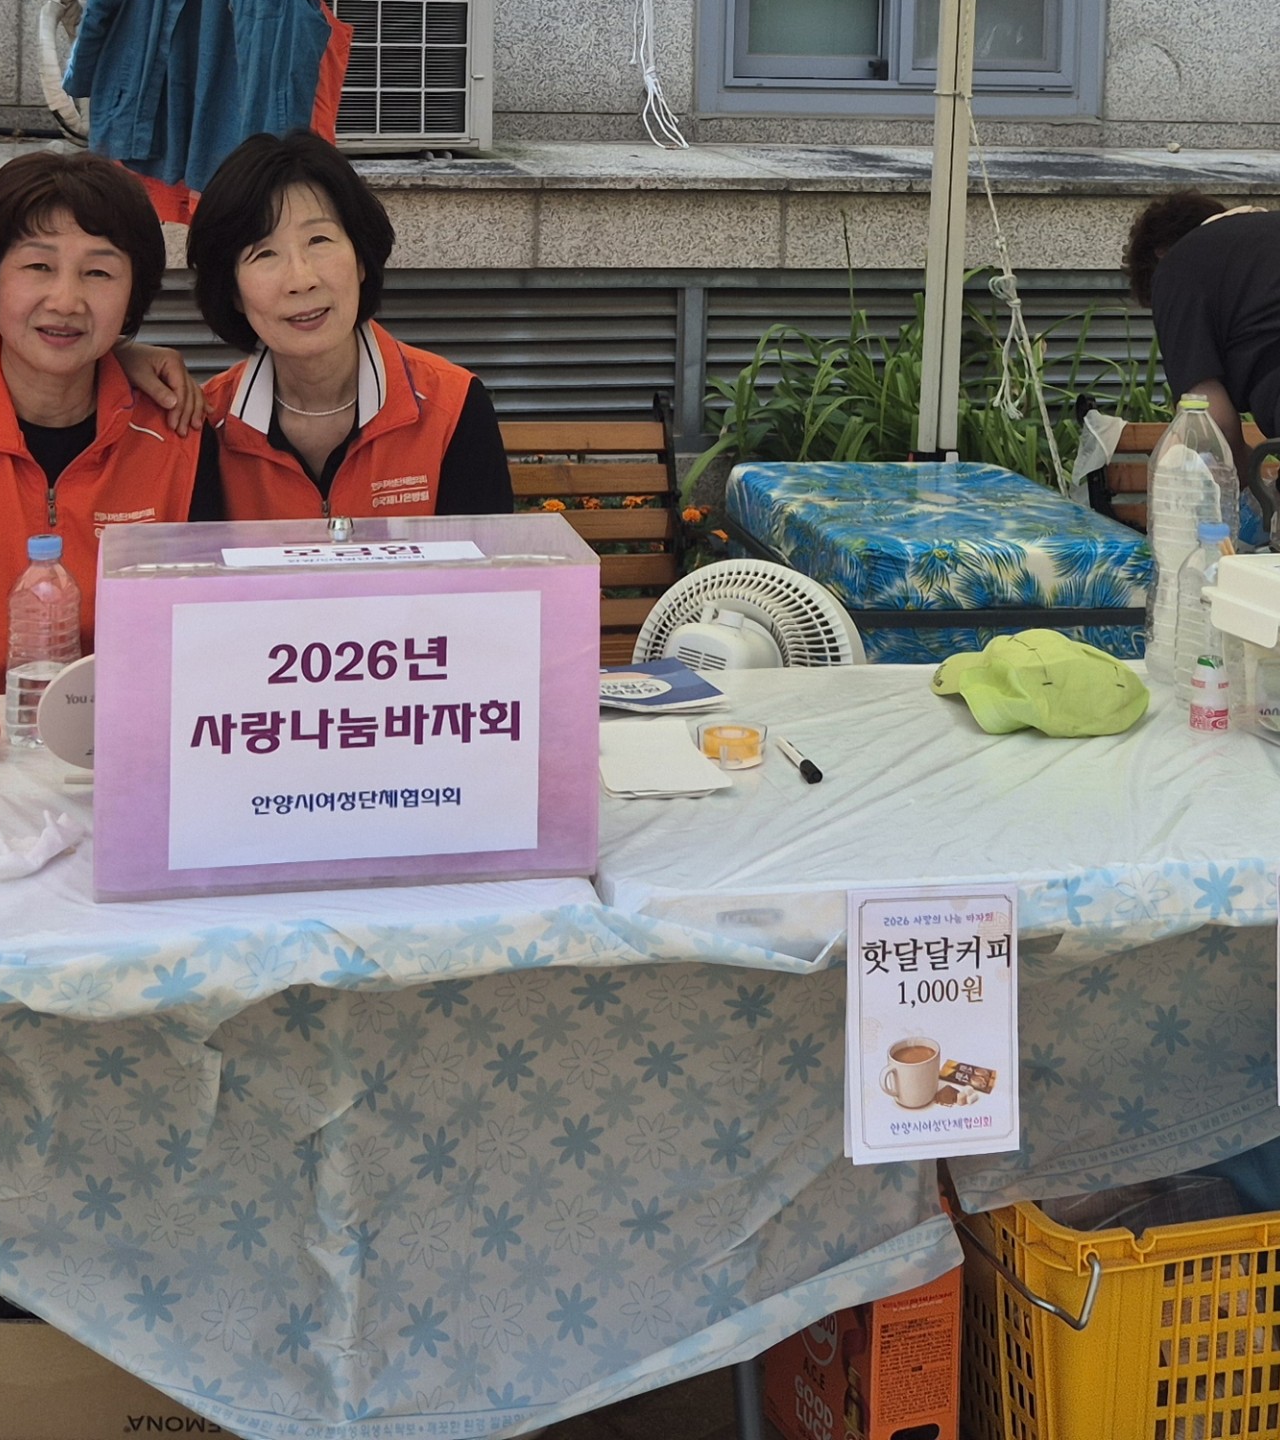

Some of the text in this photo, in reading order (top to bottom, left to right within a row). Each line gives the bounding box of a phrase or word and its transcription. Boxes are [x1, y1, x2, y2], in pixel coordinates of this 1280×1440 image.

[267, 635, 448, 685] 2026년
[190, 699, 522, 755] 사랑나눔바자회
[251, 786, 462, 816] 안양시여성단체협의회
[861, 934, 1012, 975] 핫달달커피
[898, 975, 984, 1008] 1,000원
[795, 1375, 834, 1430] GOOD
[127, 1415, 222, 1434] EMONA
